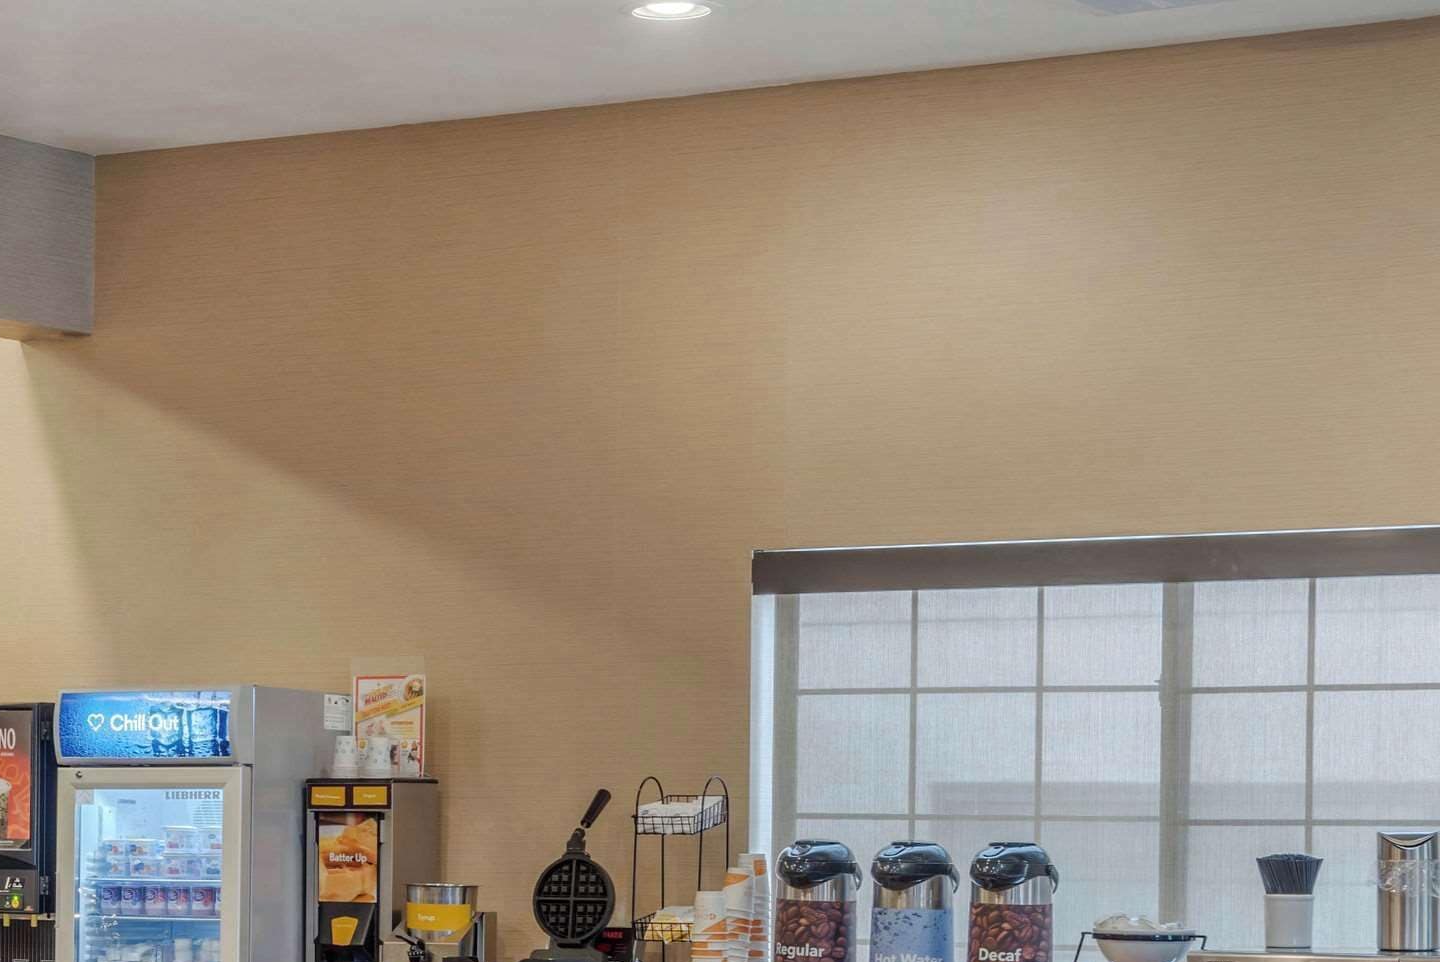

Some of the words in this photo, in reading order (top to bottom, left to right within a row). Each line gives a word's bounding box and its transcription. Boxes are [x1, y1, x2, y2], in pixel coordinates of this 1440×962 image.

[110, 713, 145, 732] Chill
[148, 713, 180, 732] Out
[165, 790, 222, 801] LIEBHERR
[328, 852, 354, 863] Batter
[355, 852, 368, 865] Up
[776, 942, 825, 960] Regular
[978, 947, 1023, 962] Decaf
